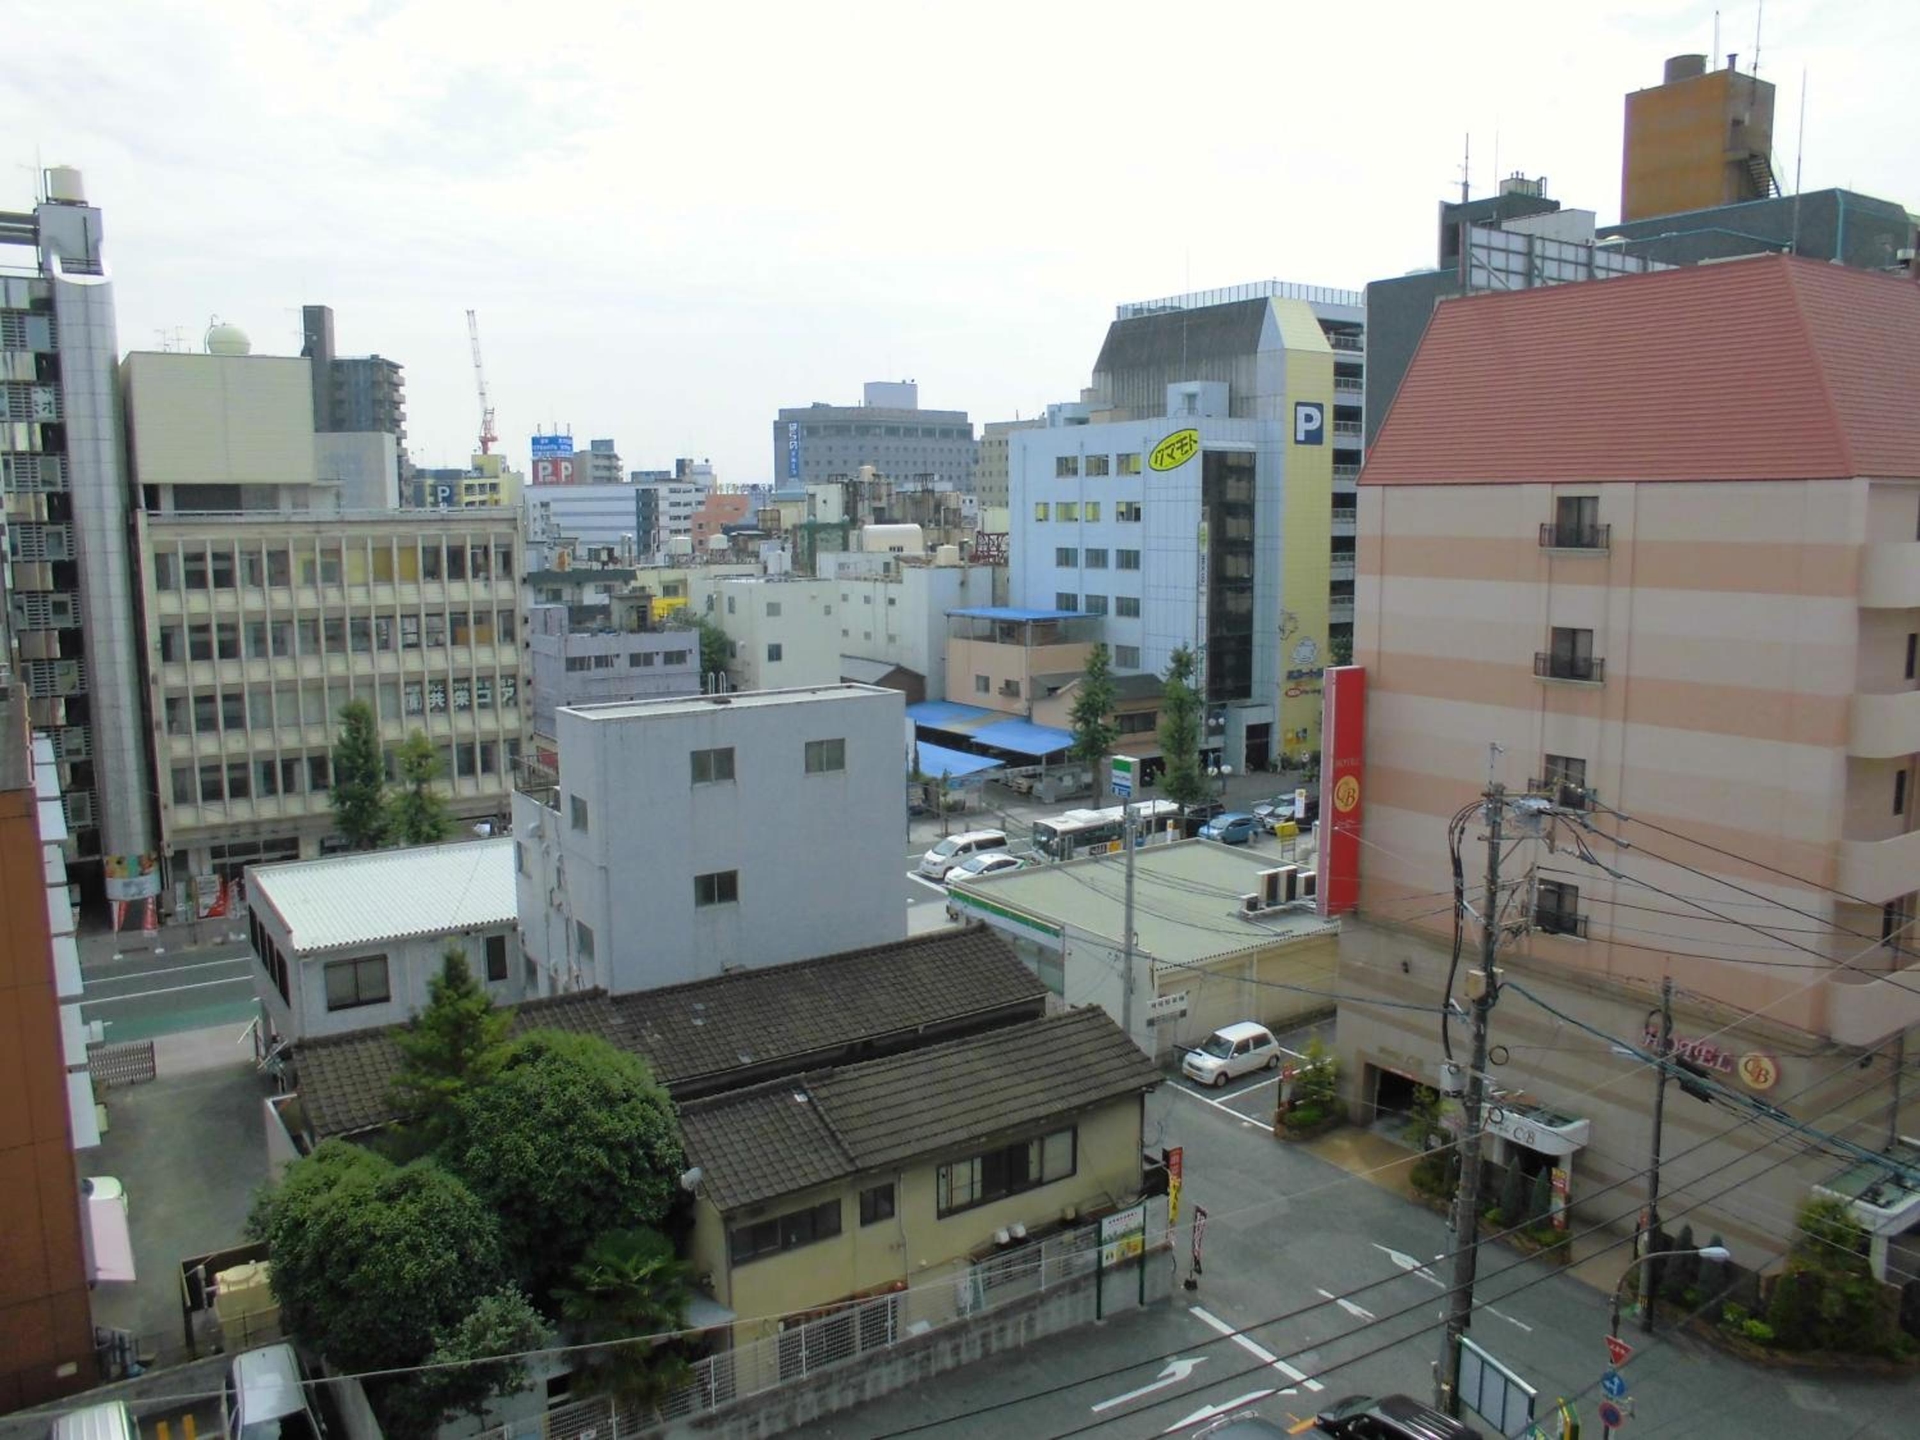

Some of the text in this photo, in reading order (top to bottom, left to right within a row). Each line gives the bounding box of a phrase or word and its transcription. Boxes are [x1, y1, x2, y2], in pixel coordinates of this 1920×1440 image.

[1296, 406, 1322, 441] P
[538, 461, 553, 482] P
[561, 461, 573, 482] P
[437, 486, 450, 502] P
[1513, 1127, 1536, 1145] CB
